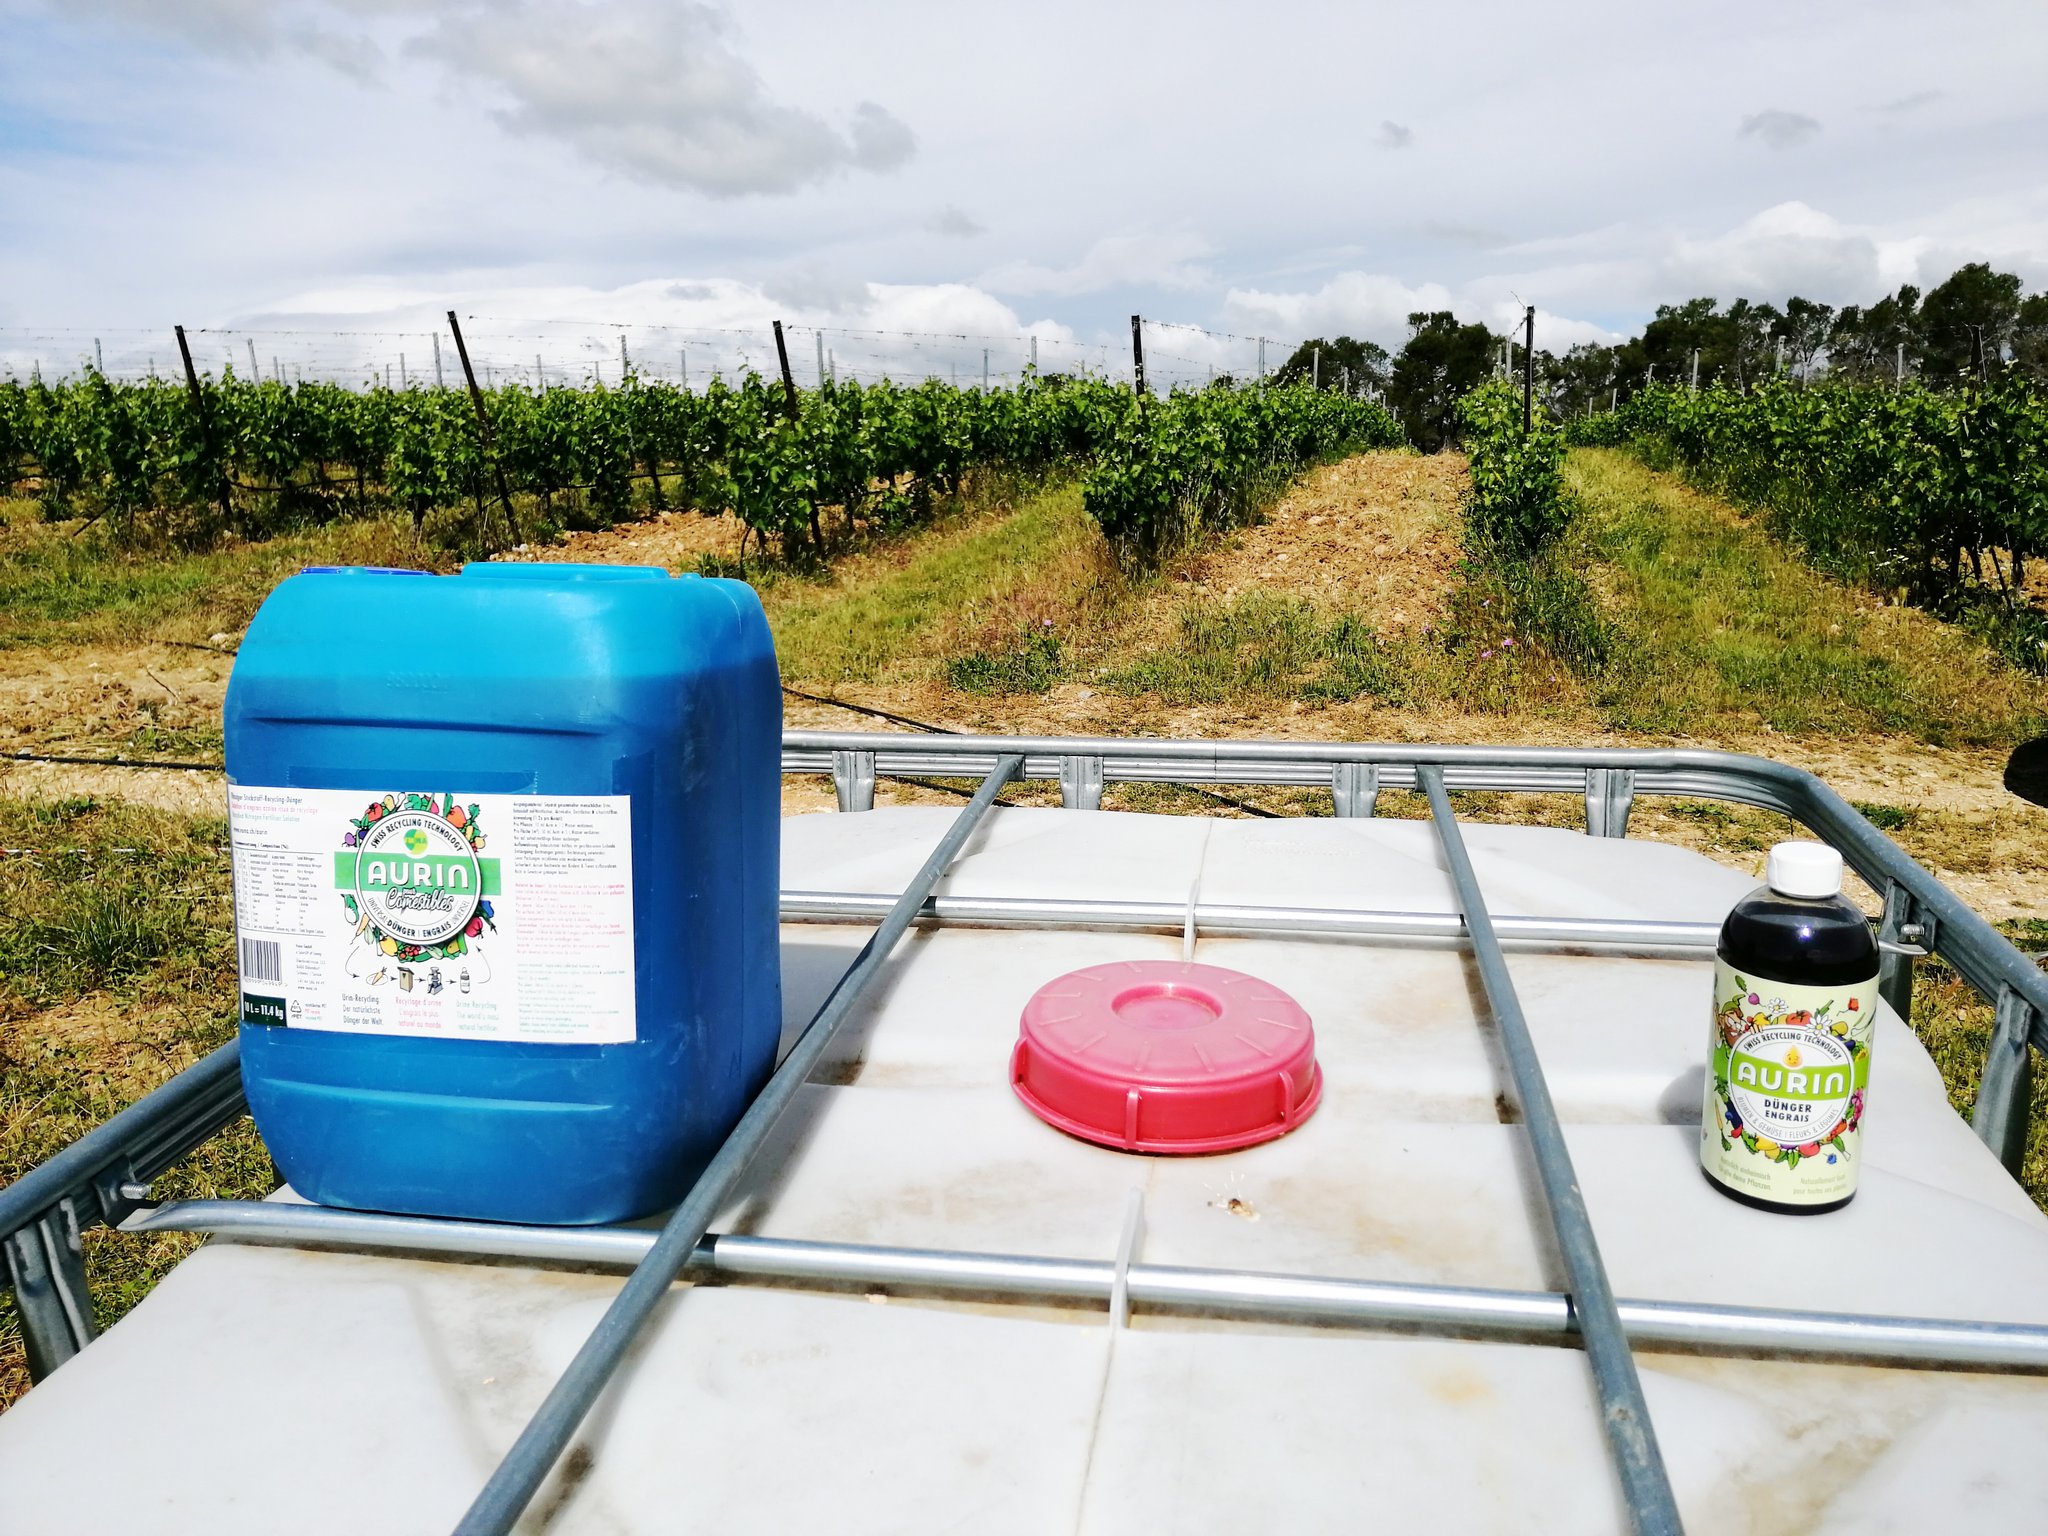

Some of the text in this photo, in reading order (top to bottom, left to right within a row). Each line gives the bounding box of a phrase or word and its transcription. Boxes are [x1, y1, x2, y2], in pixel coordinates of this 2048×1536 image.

[371, 818, 464, 851] SWISS RECYCLING TECHNOLOGY
[368, 861, 469, 889] AURIN
[386, 886, 455, 913] Comestibles
[388, 919, 416, 937] DÜNGER
[423, 920, 452, 938] ENGRAIS
[261, 1004, 274, 1016] 11.4
[275, 1005, 284, 1020] kg
[1744, 1032, 1842, 1060] SWISS RECYCLING TECHNOLOGY
[1738, 1061, 1845, 1095] AURIN
[1764, 1098, 1812, 1113] DÜNGER
[1765, 1110, 1809, 1123] ENGRAIS
[1759, 1123, 1784, 1137] GEMÜSE
[1789, 1129, 1811, 1139] FLEURS
